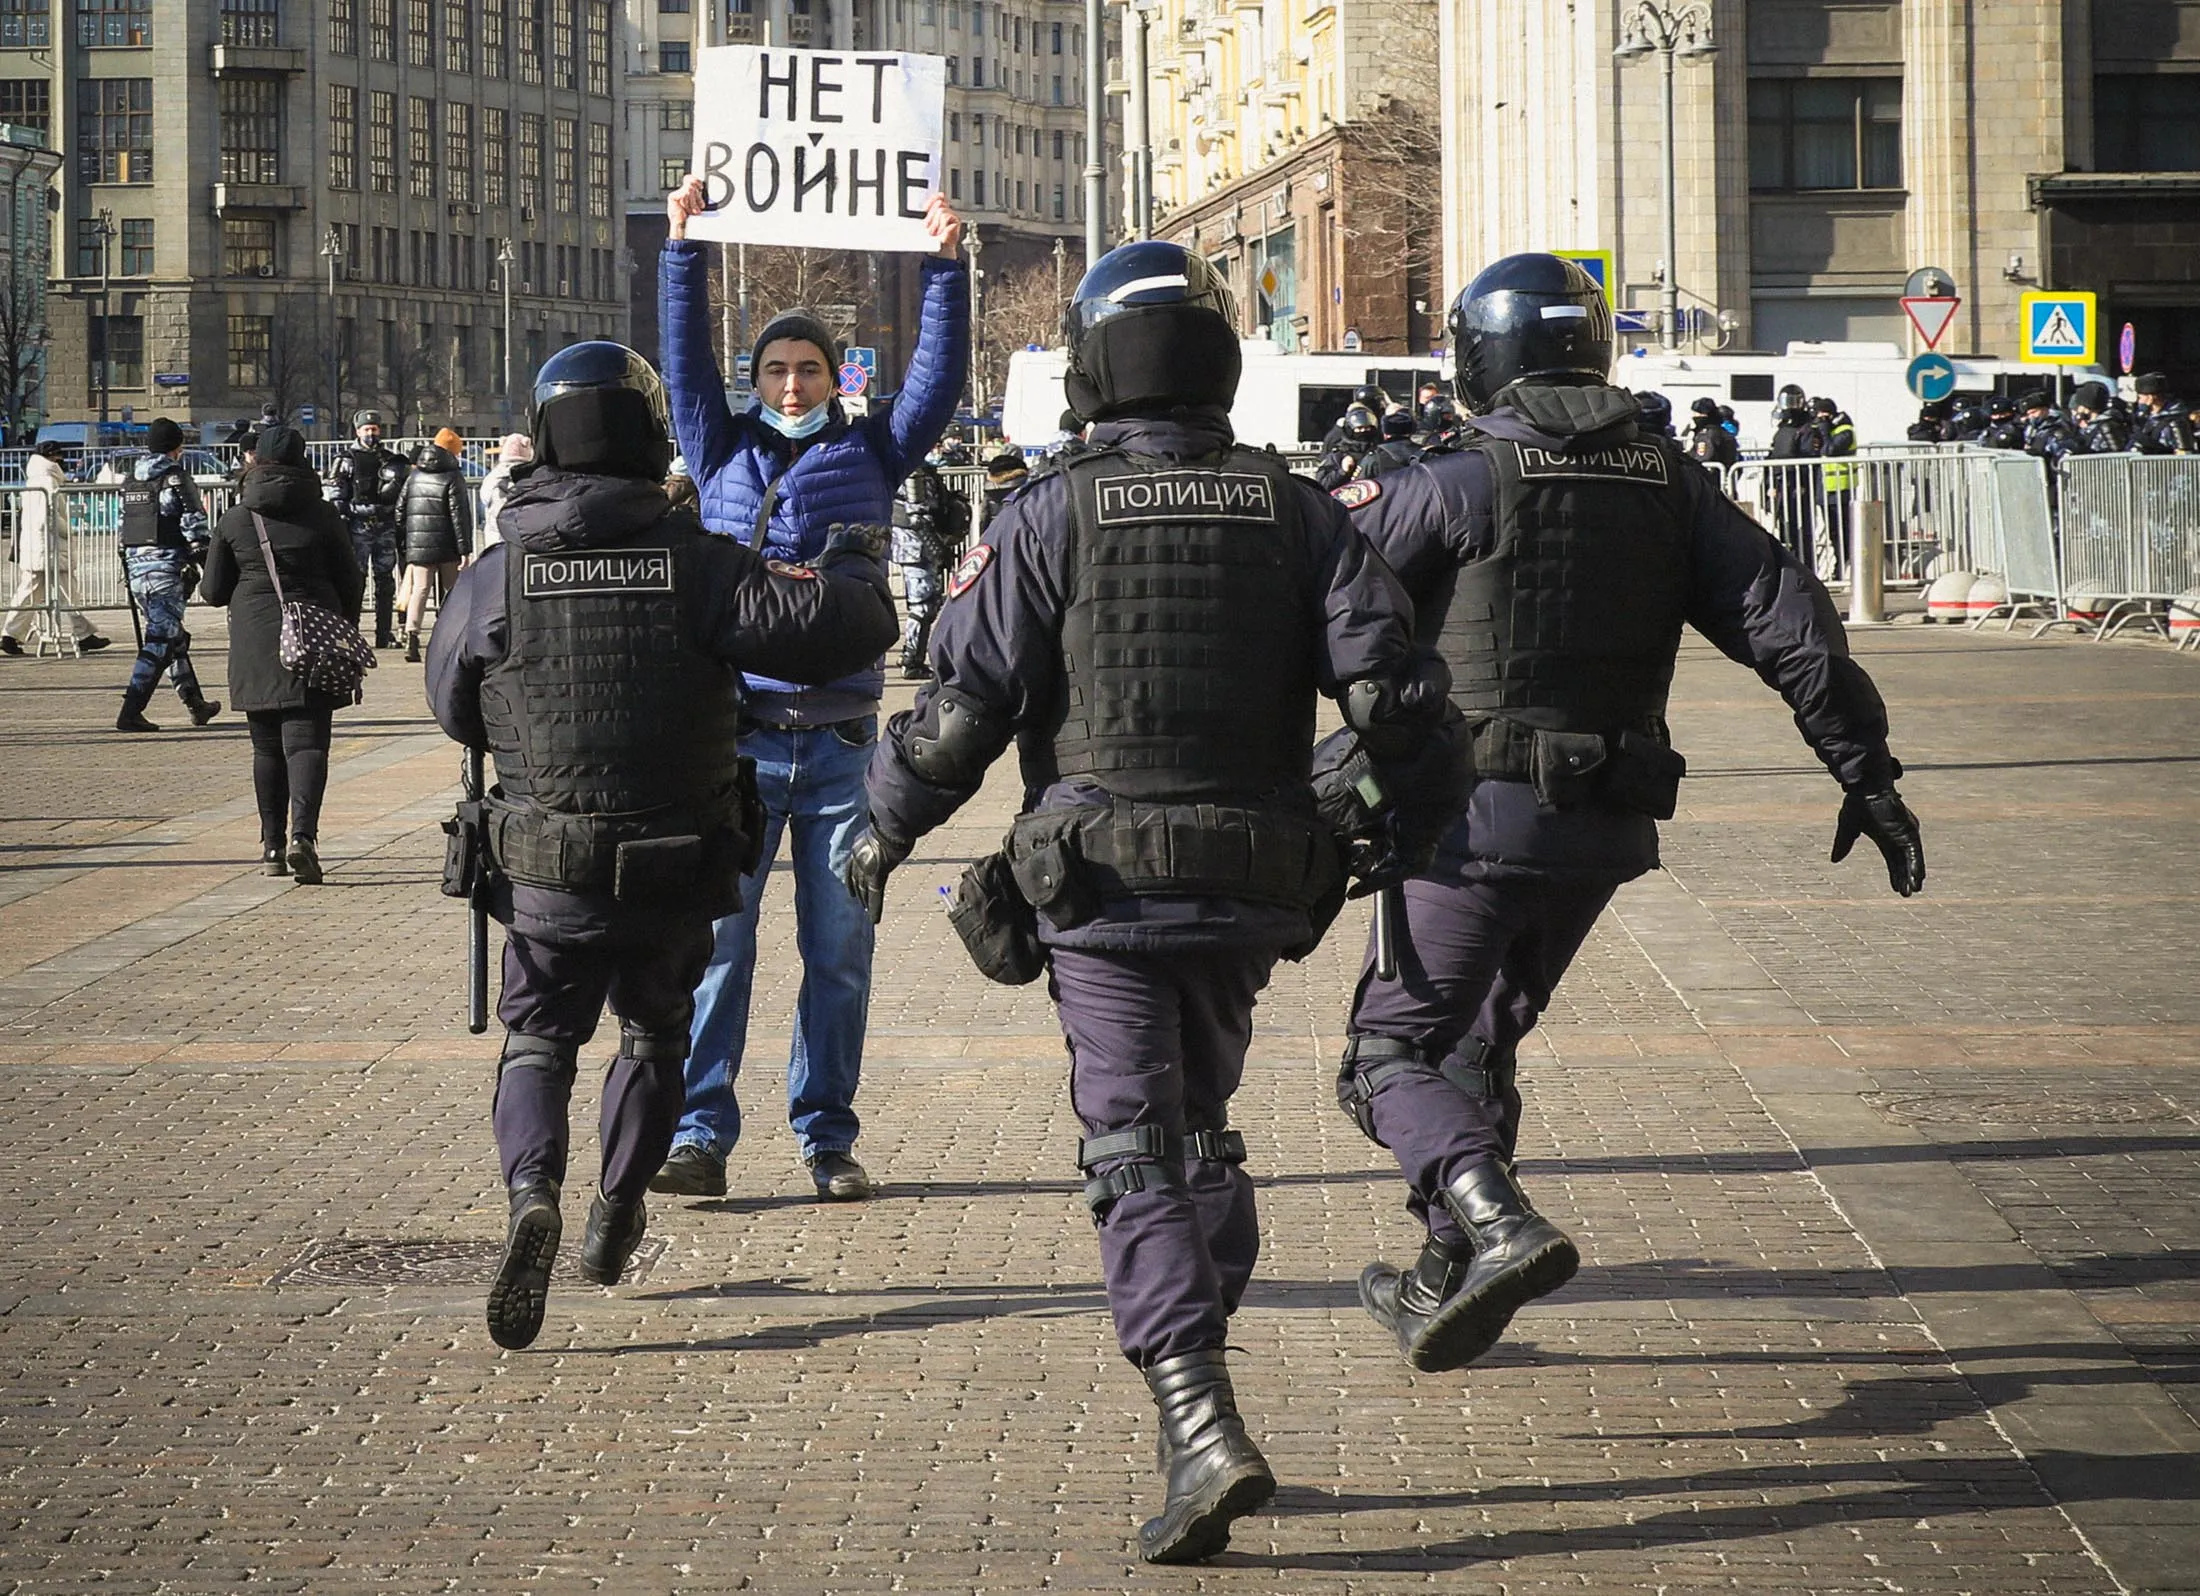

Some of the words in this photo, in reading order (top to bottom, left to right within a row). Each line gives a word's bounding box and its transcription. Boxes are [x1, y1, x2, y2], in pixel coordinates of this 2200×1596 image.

[759, 53, 898, 124] НЕТ
[702, 132, 930, 219] ВОЙНЕ
[1103, 481, 1267, 511] ПОЛИЦИЯ
[529, 558, 665, 585] ПОЛИЦИЯ
